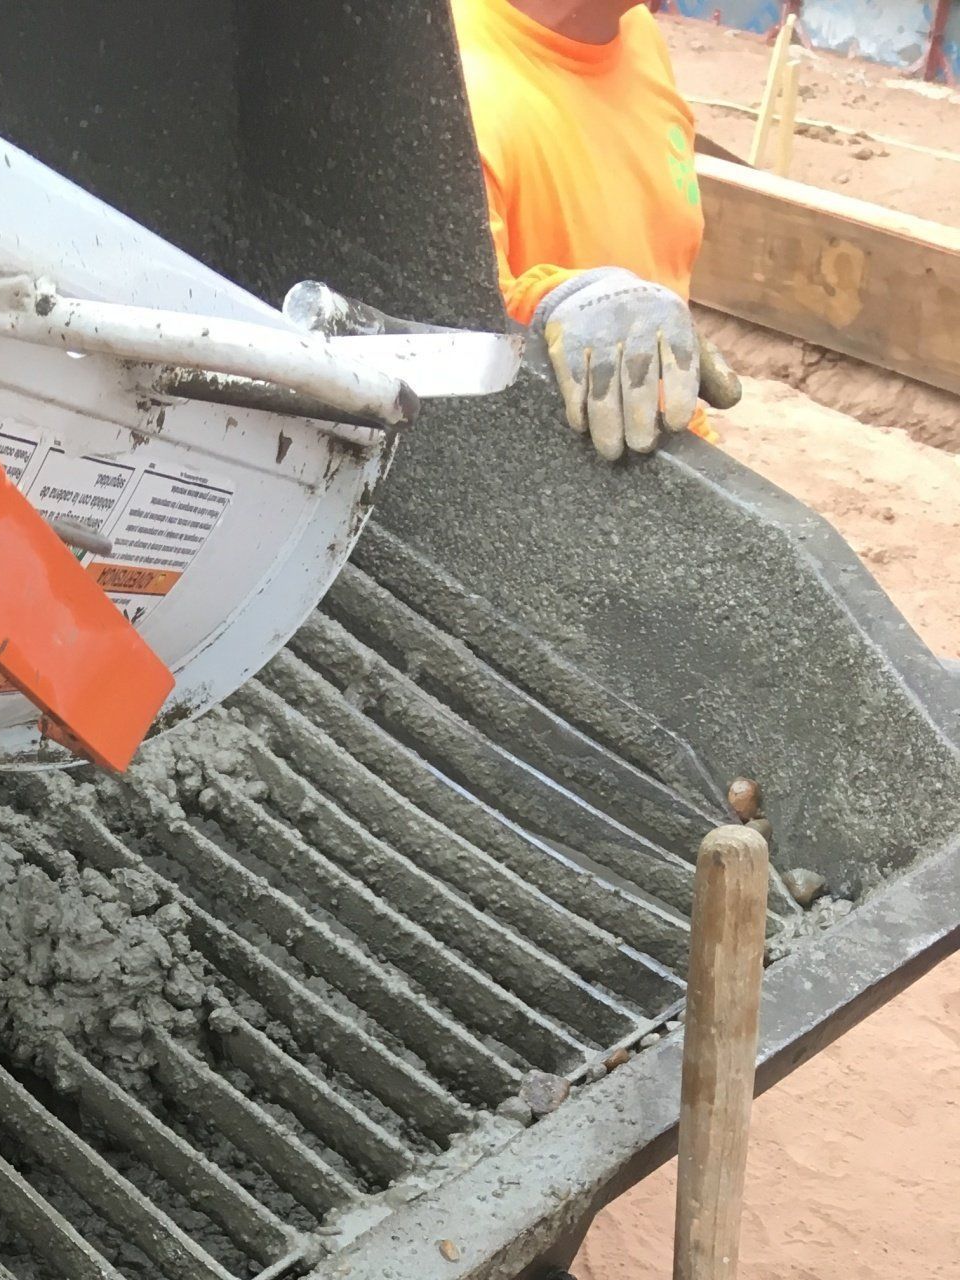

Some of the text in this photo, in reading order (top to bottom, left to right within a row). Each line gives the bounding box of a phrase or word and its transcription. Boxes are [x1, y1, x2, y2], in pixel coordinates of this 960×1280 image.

[39, 485, 51, 500] de
[49, 486, 74, 503] cadena
[79, 493, 92, 506] con
[91, 495, 115, 510] doblada
